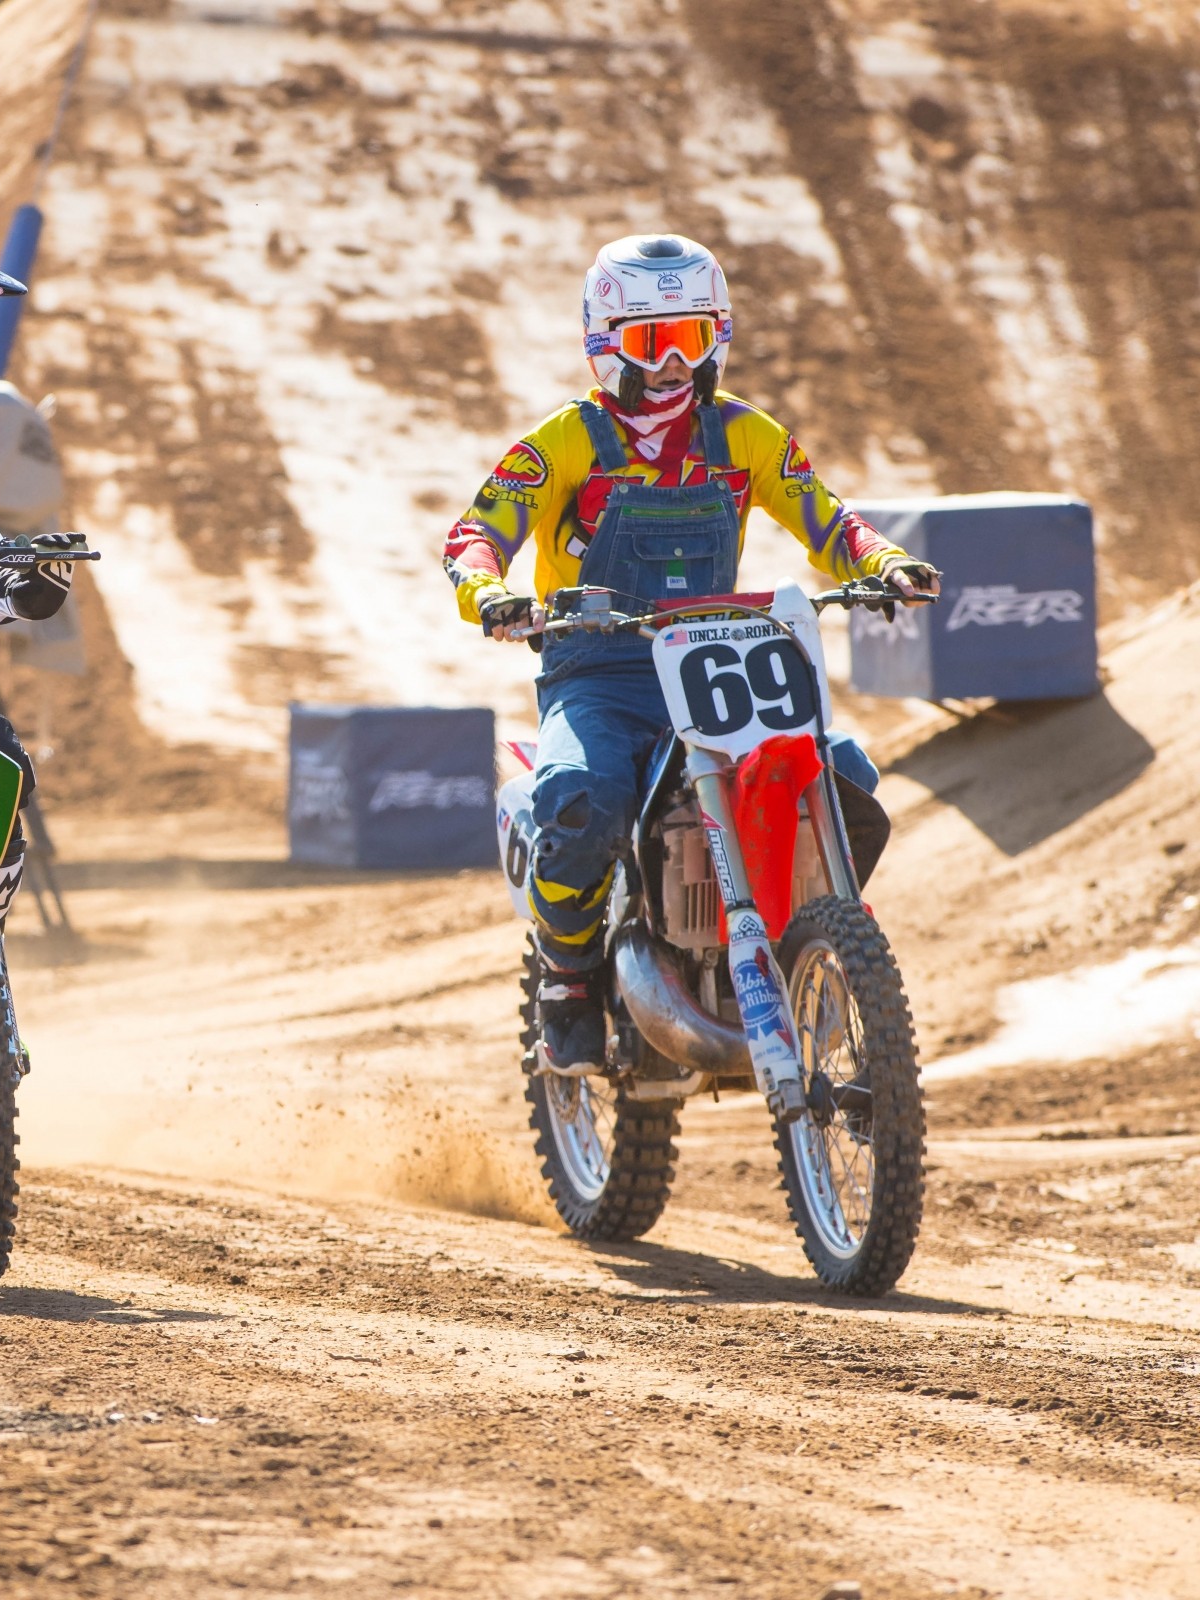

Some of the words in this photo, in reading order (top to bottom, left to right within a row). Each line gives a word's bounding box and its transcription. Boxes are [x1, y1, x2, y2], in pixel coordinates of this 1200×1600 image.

[0, 554, 36, 563] ARC
[688, 627, 730, 643] UNCLE
[679, 638, 817, 737] 69
[735, 973, 769, 995] Pabst
